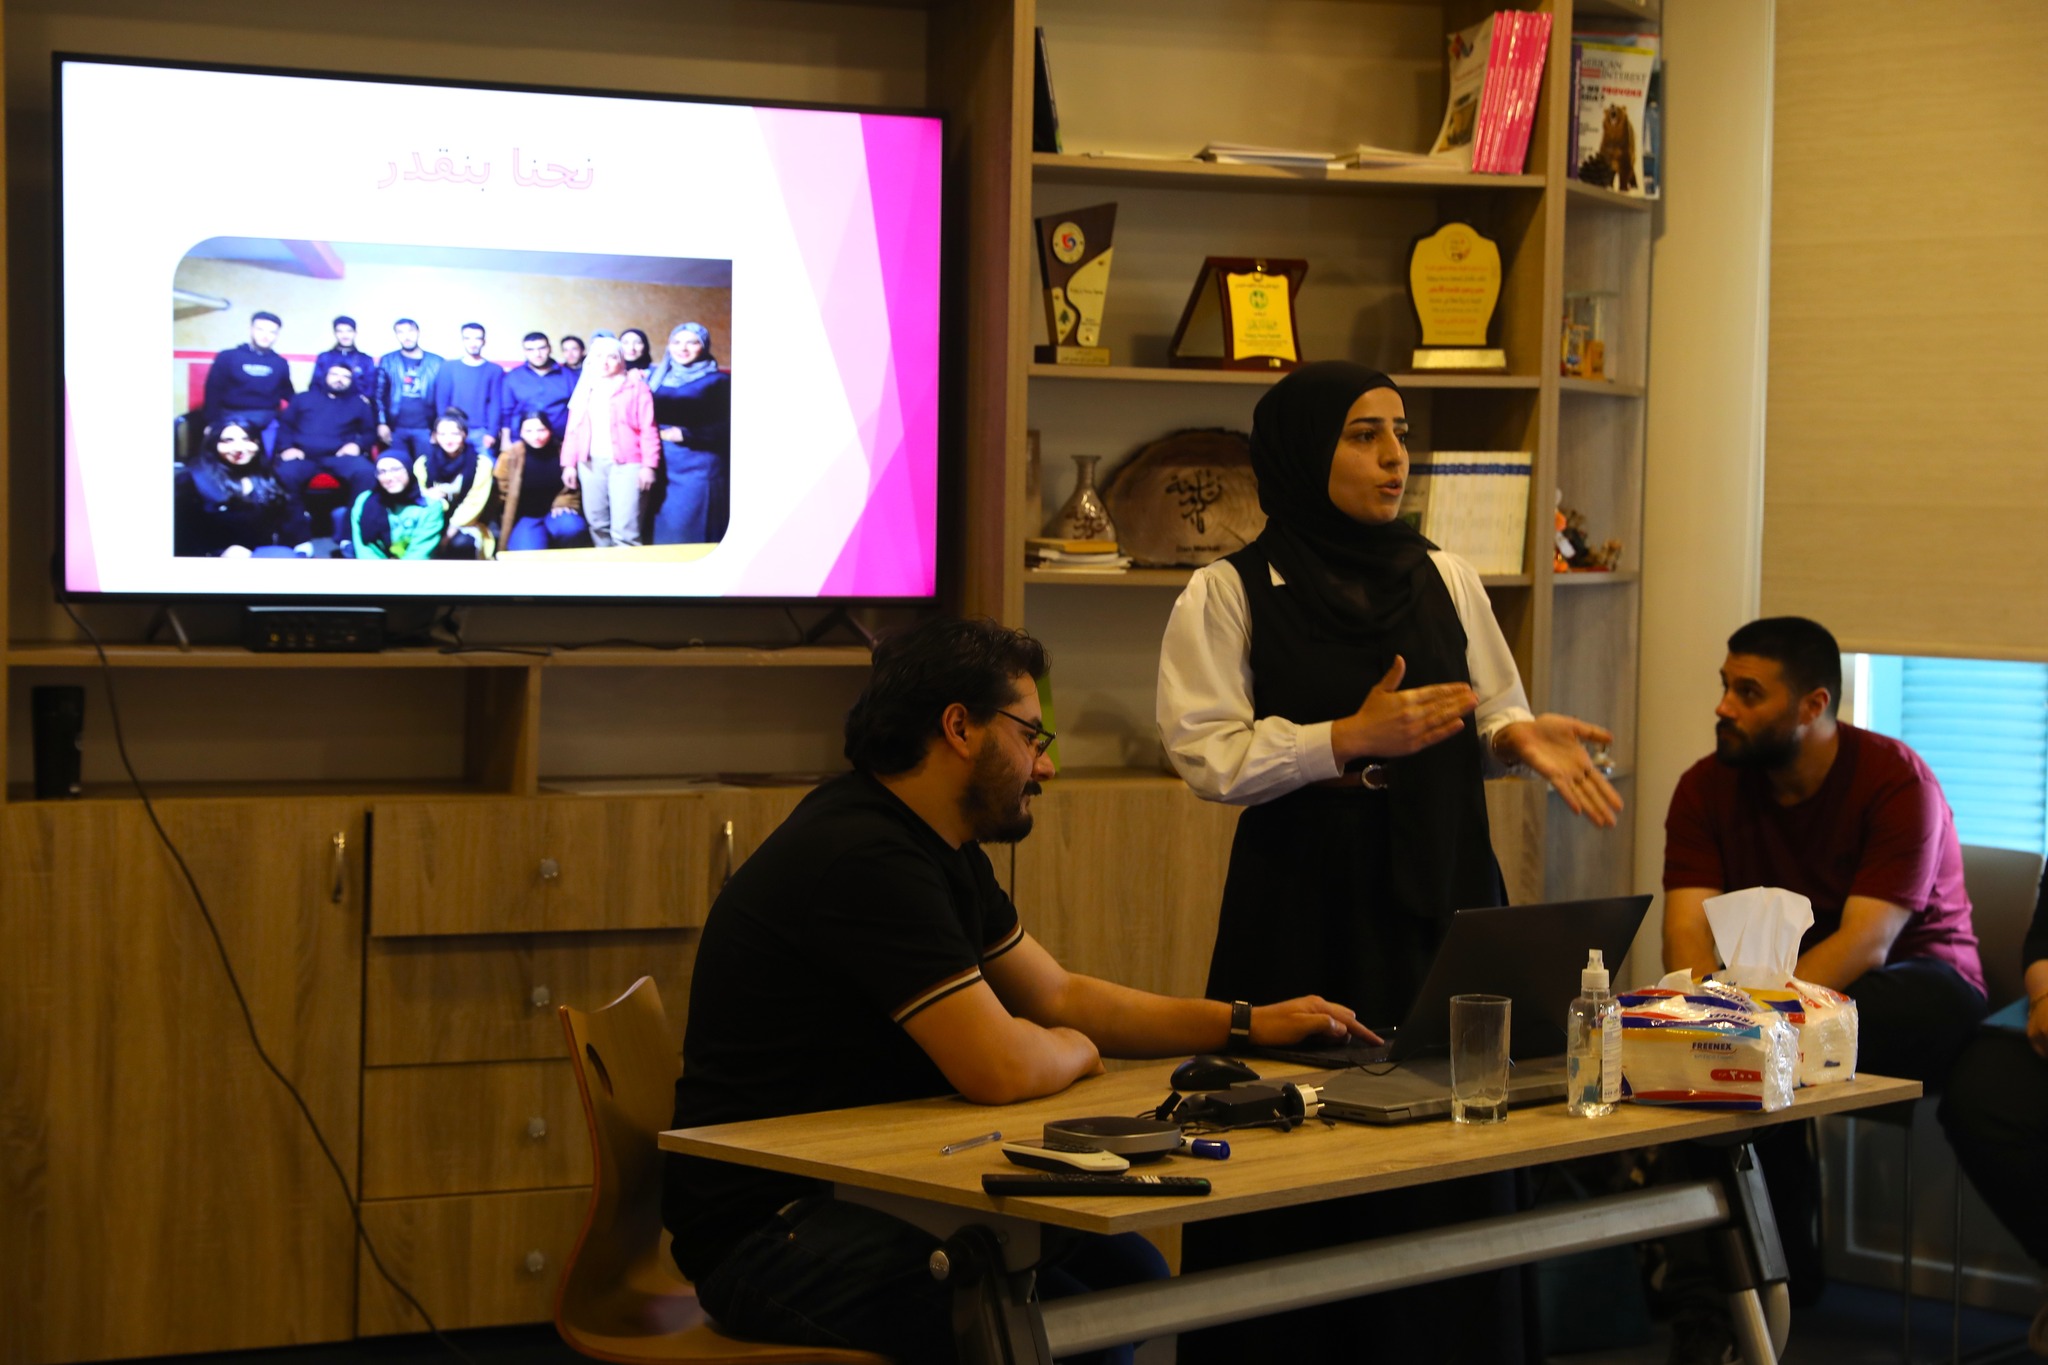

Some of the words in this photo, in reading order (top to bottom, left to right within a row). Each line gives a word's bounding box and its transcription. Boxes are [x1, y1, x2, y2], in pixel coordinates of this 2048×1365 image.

[377, 147, 491, 192] بنقدر
[512, 146, 594, 190] نحنا
[1691, 1042, 1732, 1051] FREENEX
